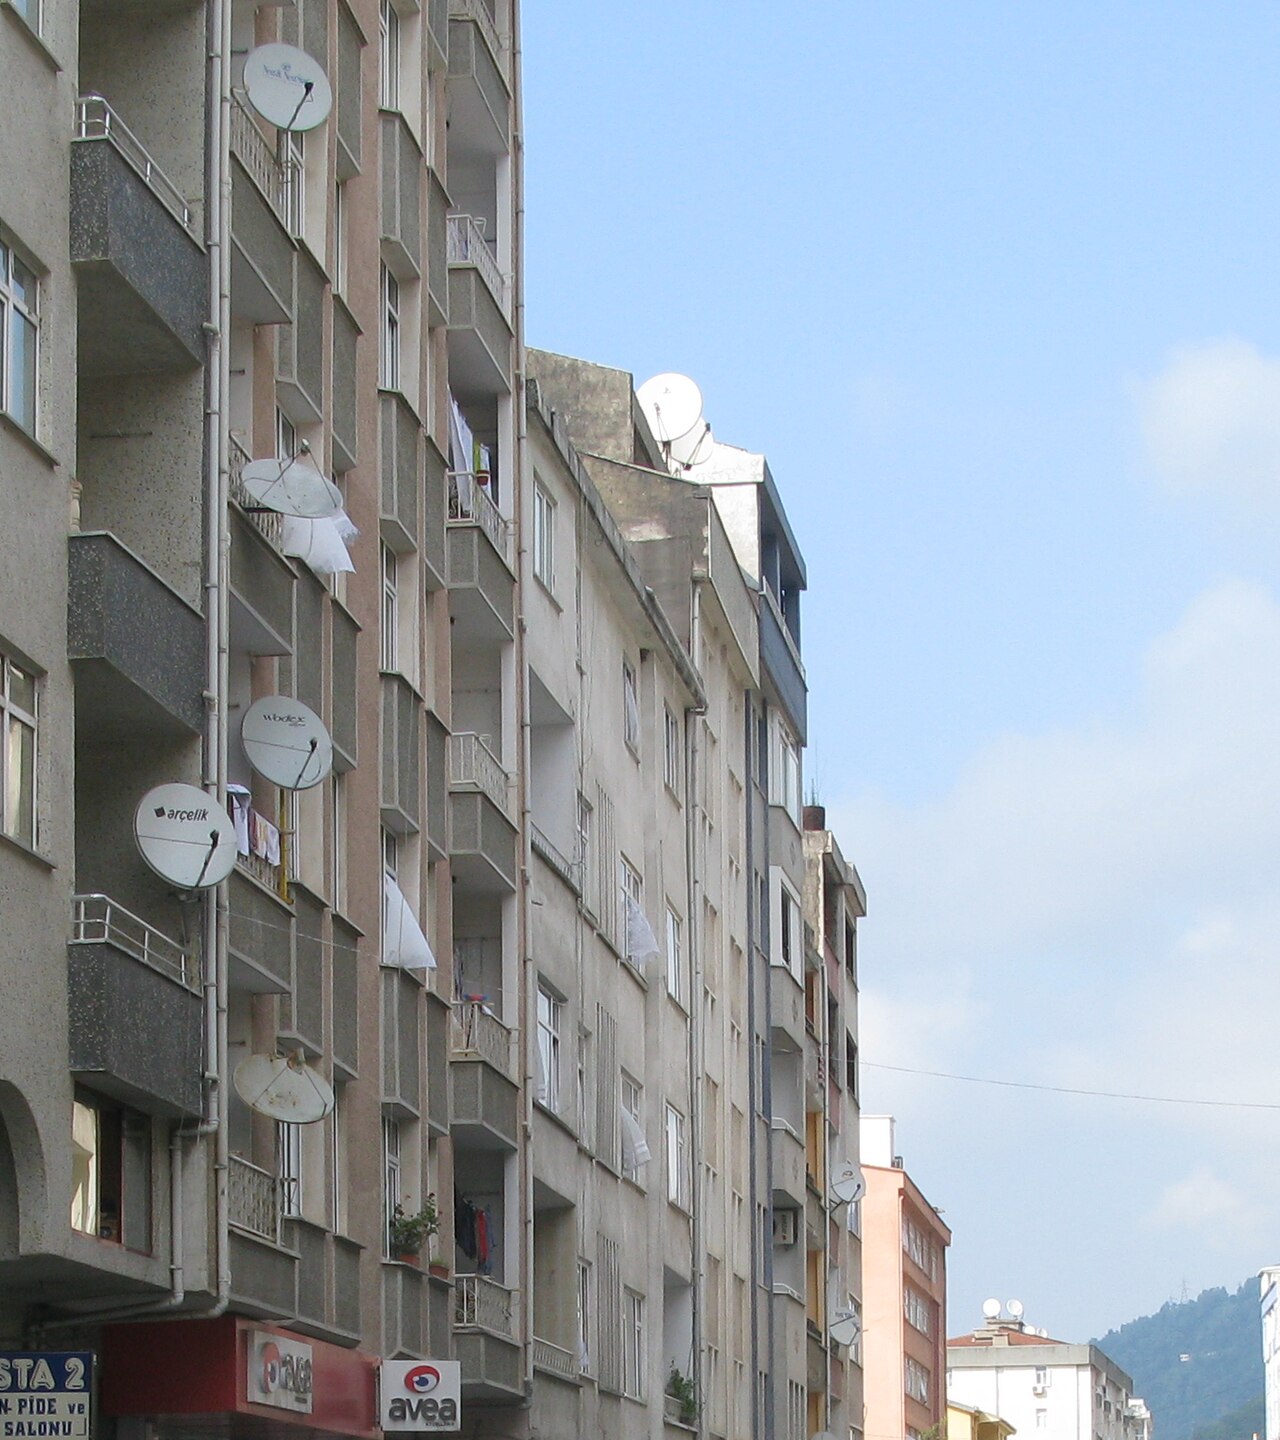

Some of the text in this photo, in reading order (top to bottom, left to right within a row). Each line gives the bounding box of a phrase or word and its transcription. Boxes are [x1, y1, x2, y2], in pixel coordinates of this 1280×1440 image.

[167, 807, 209, 823] arçelik
[64, 1357, 85, 1390] 2
[17, 1395, 57, 1415] PİDE
[68, 1403, 85, 1415] ve
[388, 1397, 457, 1422] avea
[4, 1420, 73, 1437] SALONU
